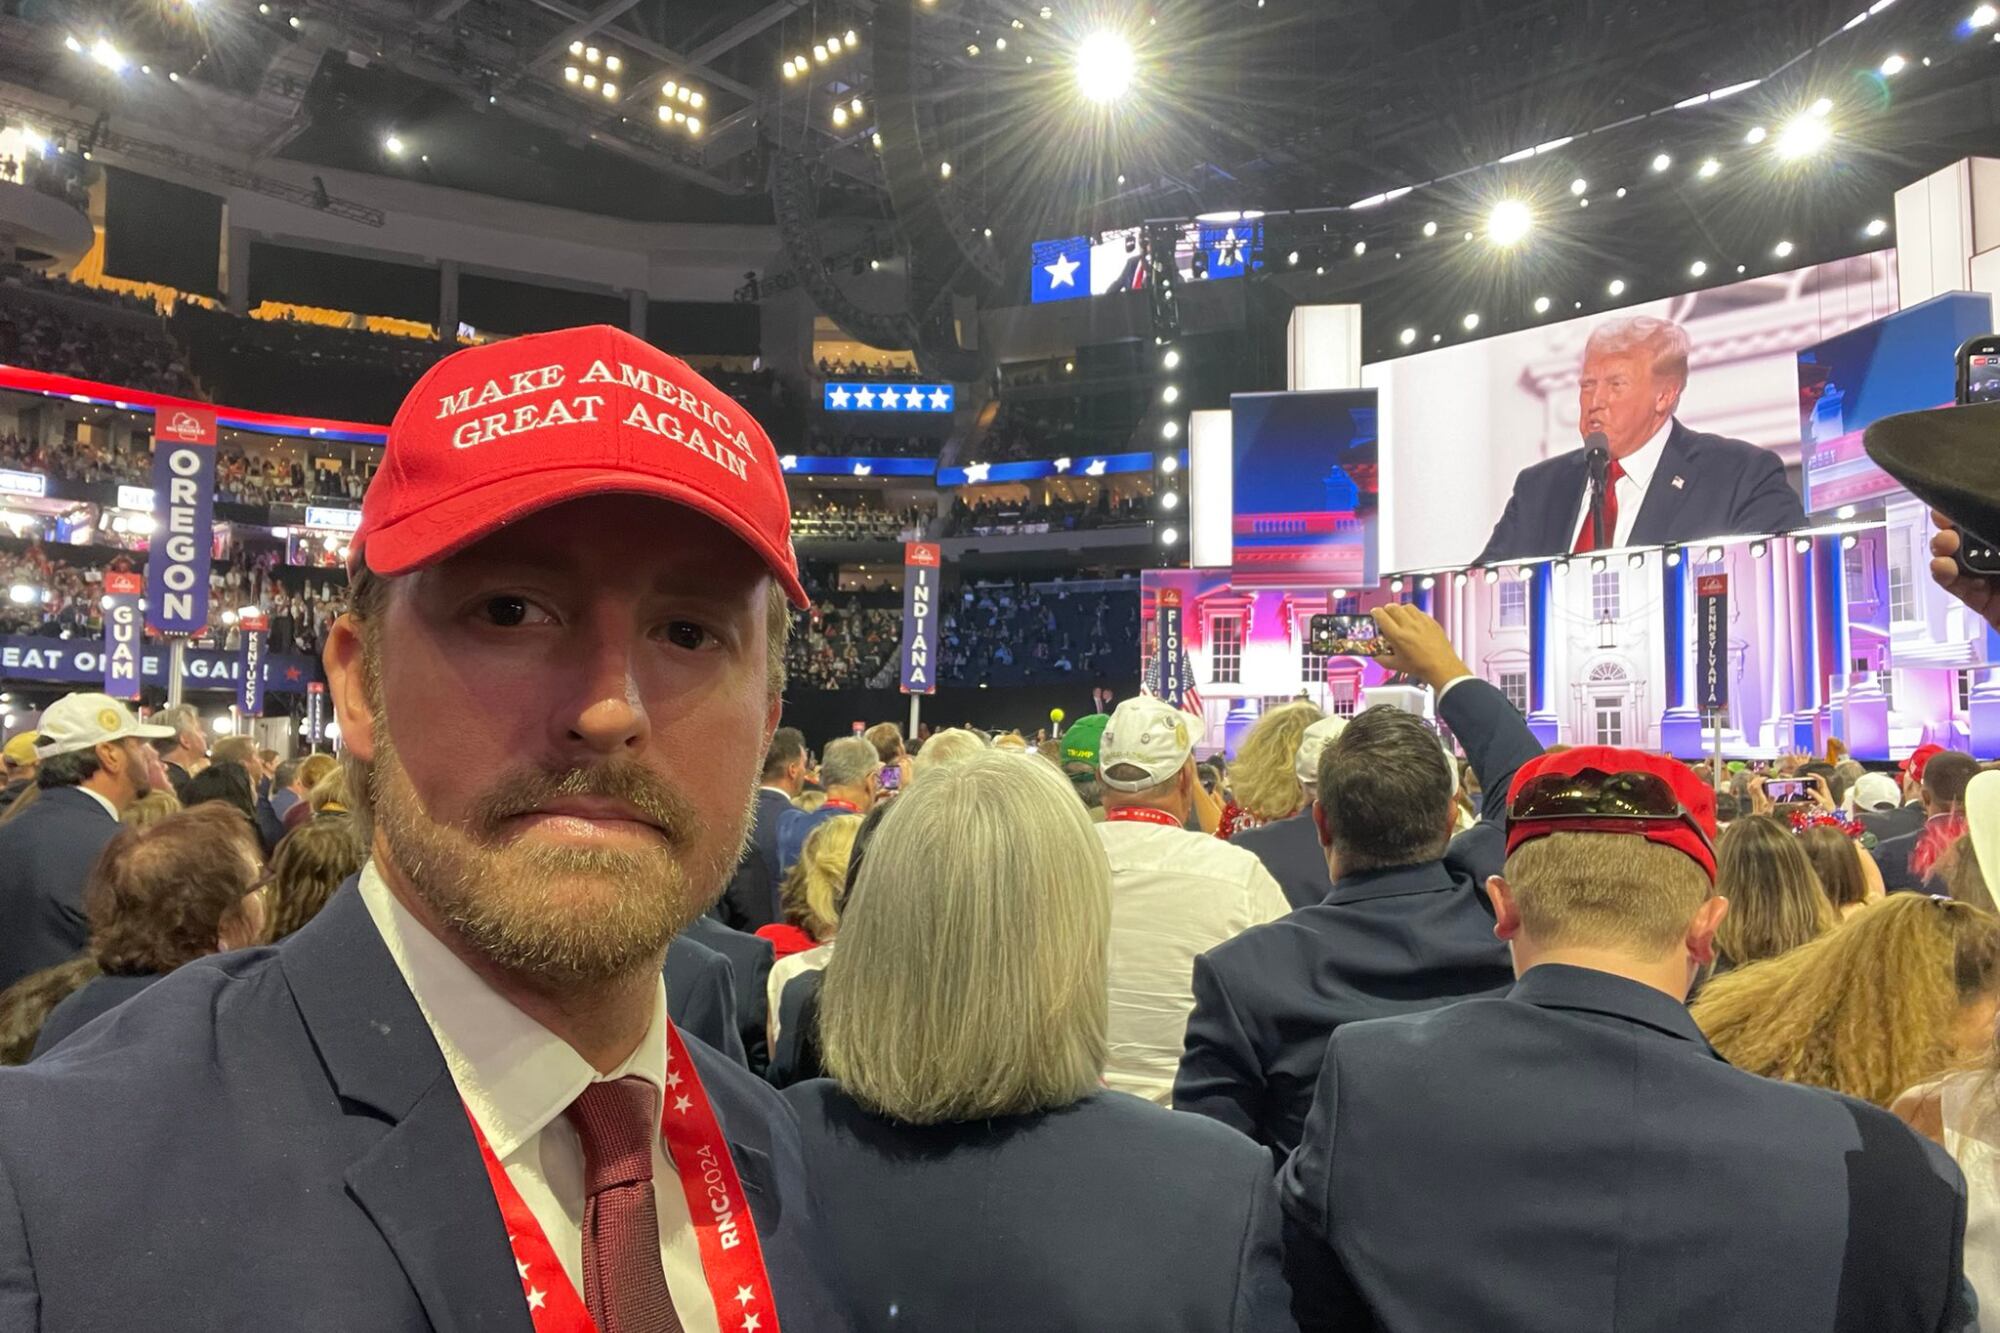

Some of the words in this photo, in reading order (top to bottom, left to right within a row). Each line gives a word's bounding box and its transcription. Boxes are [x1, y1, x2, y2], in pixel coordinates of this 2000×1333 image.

[435, 364, 566, 420] MAKE
[577, 359, 758, 464] AMERICA
[453, 395, 606, 449] GREAT
[622, 402, 748, 481] AGAIN
[163, 448, 201, 620] OREGON
[74, 652, 159, 675] OE
[111, 605, 134, 679] GUAM
[245, 631, 259, 710] KENTUCKY
[909, 569, 929, 683] INDIANA
[1166, 609, 1178, 703] FLORIDA
[1708, 597, 1717, 702] PENNSYLVANIA
[696, 1144, 741, 1250] RNC2024
